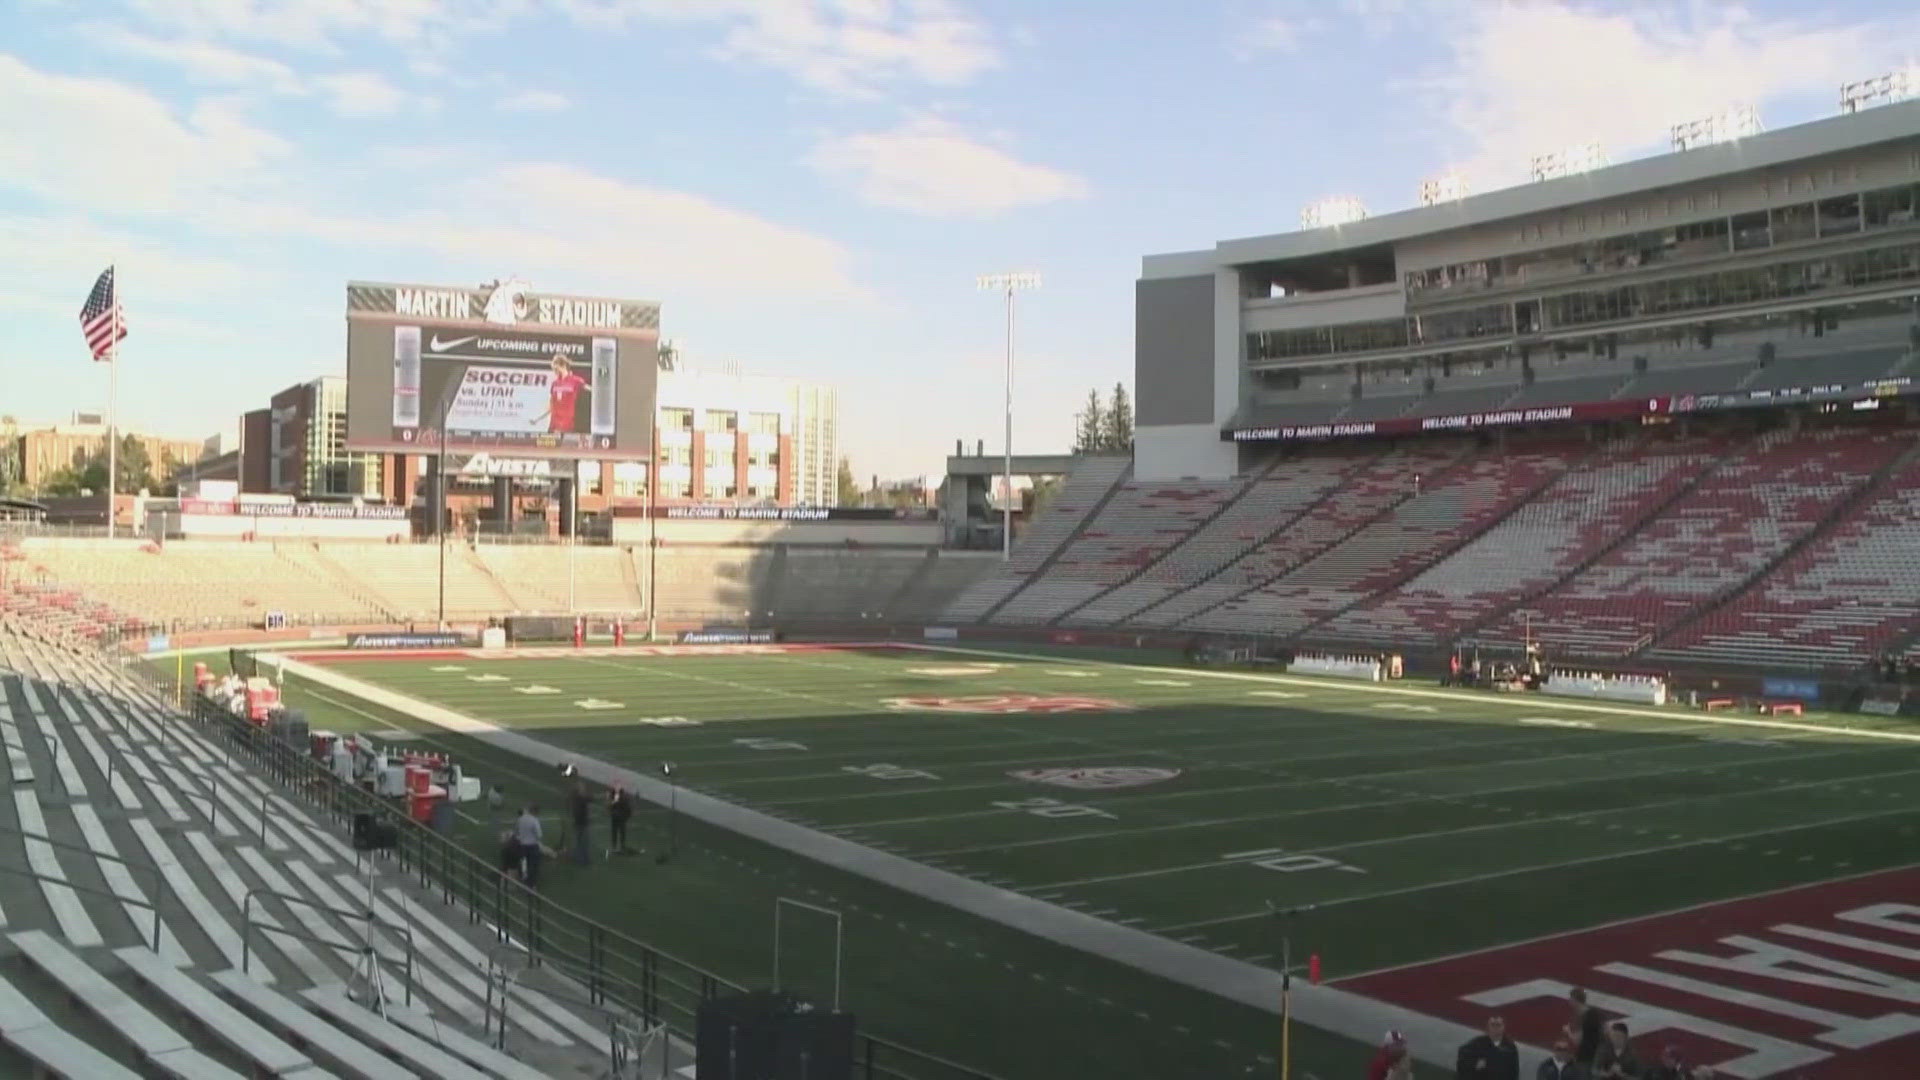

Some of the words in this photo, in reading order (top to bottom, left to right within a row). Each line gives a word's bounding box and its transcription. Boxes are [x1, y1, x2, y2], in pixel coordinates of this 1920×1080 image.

[395, 287, 470, 319] MARTIN
[539, 298, 622, 328] STADIUM
[477, 338, 539, 352] UPCOMING
[541, 341, 585, 354] EVENTS
[464, 370, 548, 387] SOCCER
[481, 387, 514, 397] UTAH
[1422, 416, 1467, 429] WELCOME
[1470, 414, 1482, 425] TO
[1484, 411, 1521, 425] MARTIN
[1525, 408, 1572, 421] STADIUM
[402, 429, 412, 441] 0
[1234, 428, 1279, 440] WELCOME
[1282, 427, 1294, 438] TO
[1296, 425, 1331, 438] MARTIN
[1333, 423, 1375, 436] STADIUM
[601, 437, 610, 449] 0
[462, 452, 550, 475] AVISTA
[241, 503, 293, 516] WELCOME
[297, 505, 310, 517] TO
[313, 505, 353, 517] MARTIN
[356, 507, 405, 519] STADIUM
[668, 507, 720, 518] WELCOME
[723, 509, 736, 518] TO
[738, 509, 779, 518] MARTIN
[781, 509, 829, 519] STADIUM
